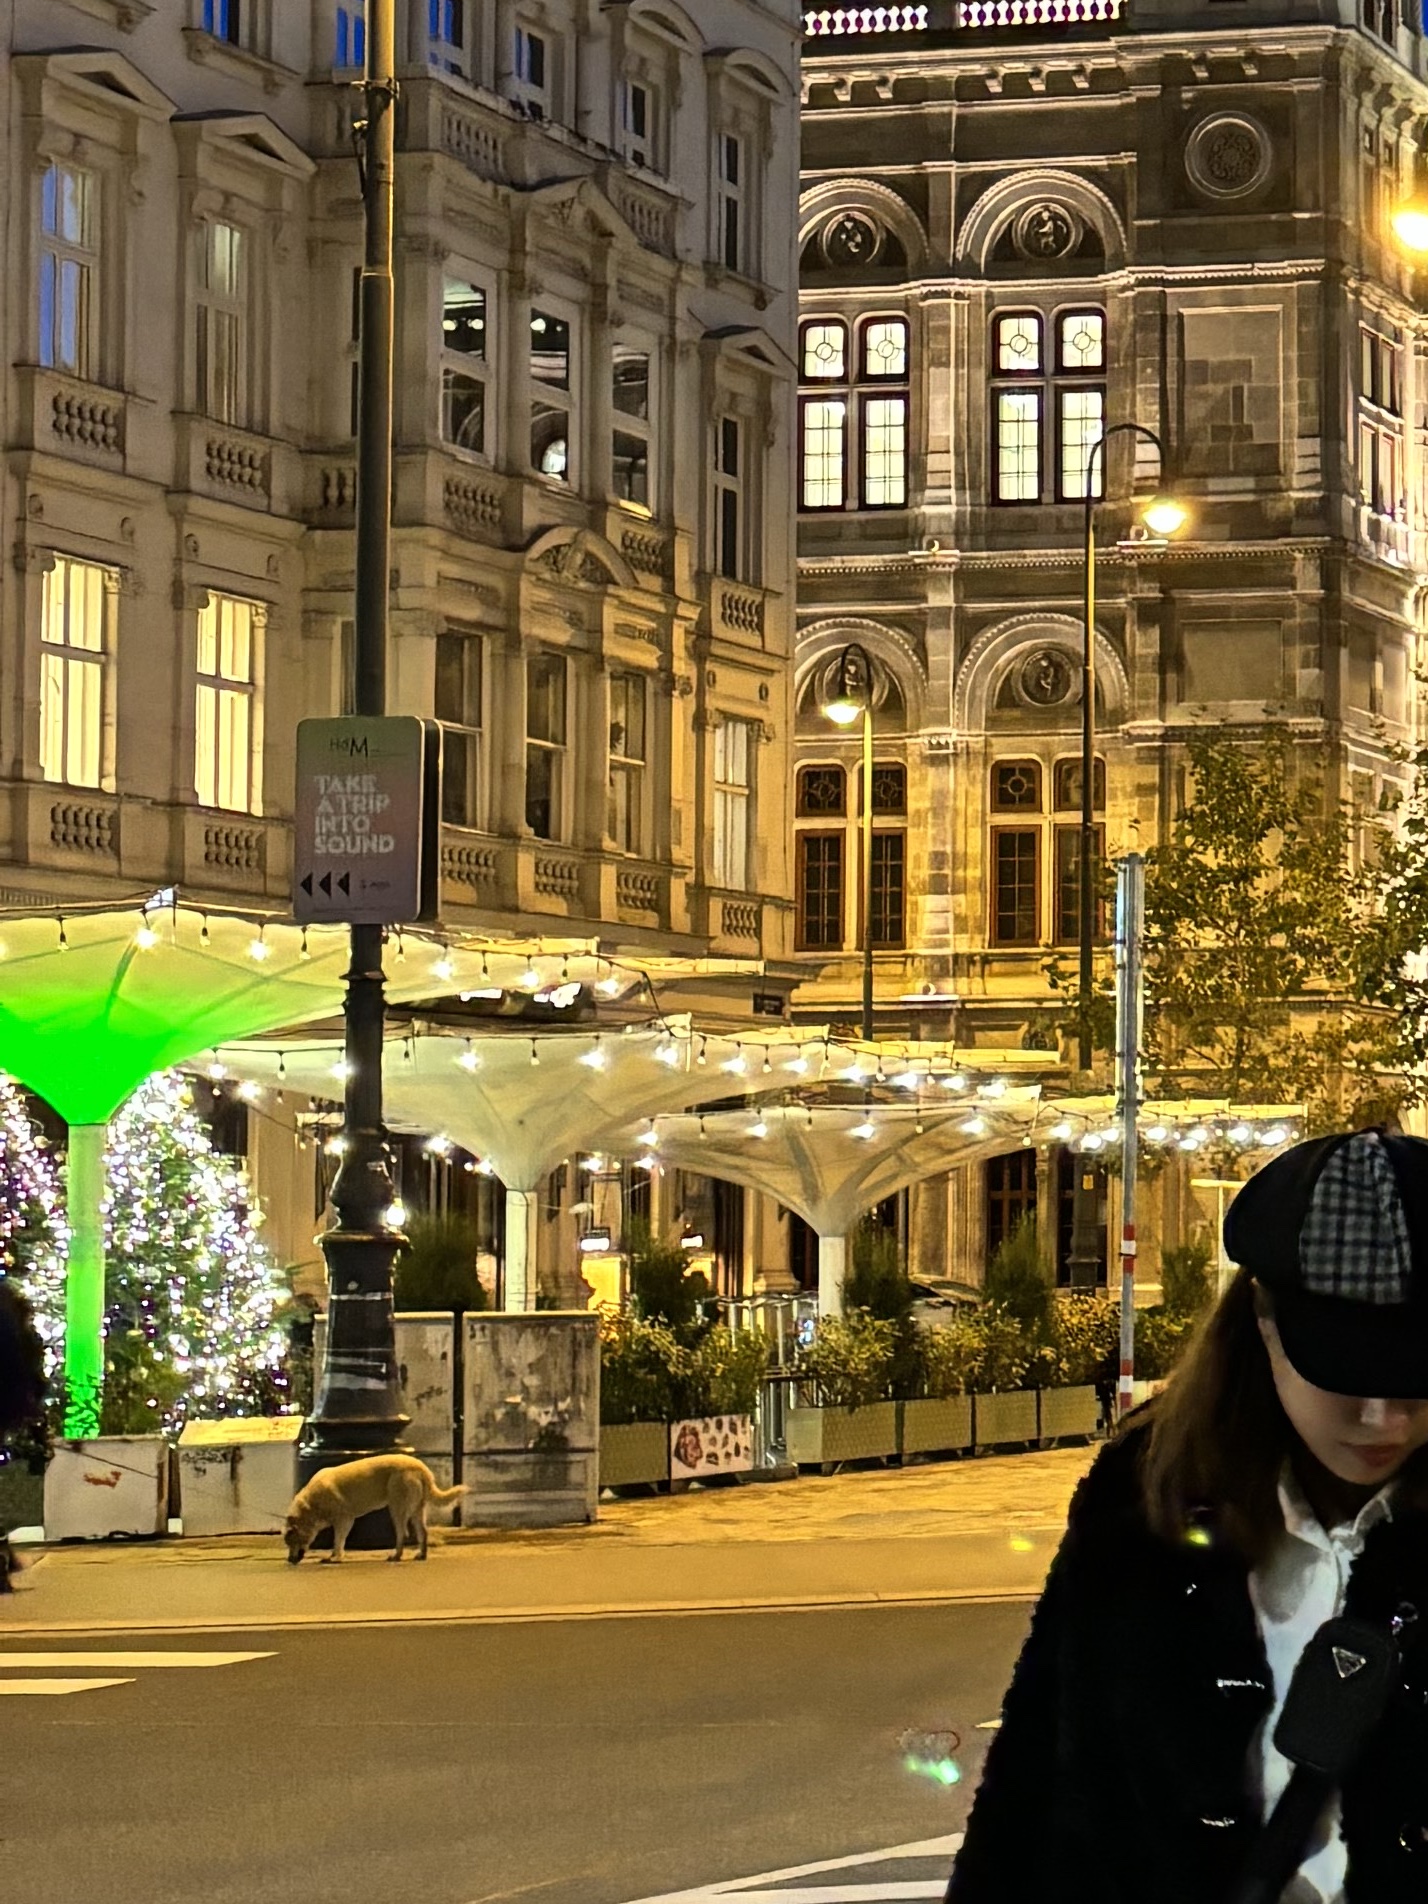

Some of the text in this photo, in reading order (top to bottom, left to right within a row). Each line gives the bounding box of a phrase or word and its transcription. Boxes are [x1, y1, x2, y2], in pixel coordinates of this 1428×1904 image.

[314, 775, 378, 795] TAKE
[317, 794, 391, 815] A TRIP
[314, 814, 371, 834] INTO
[313, 833, 395, 855] SOUND
